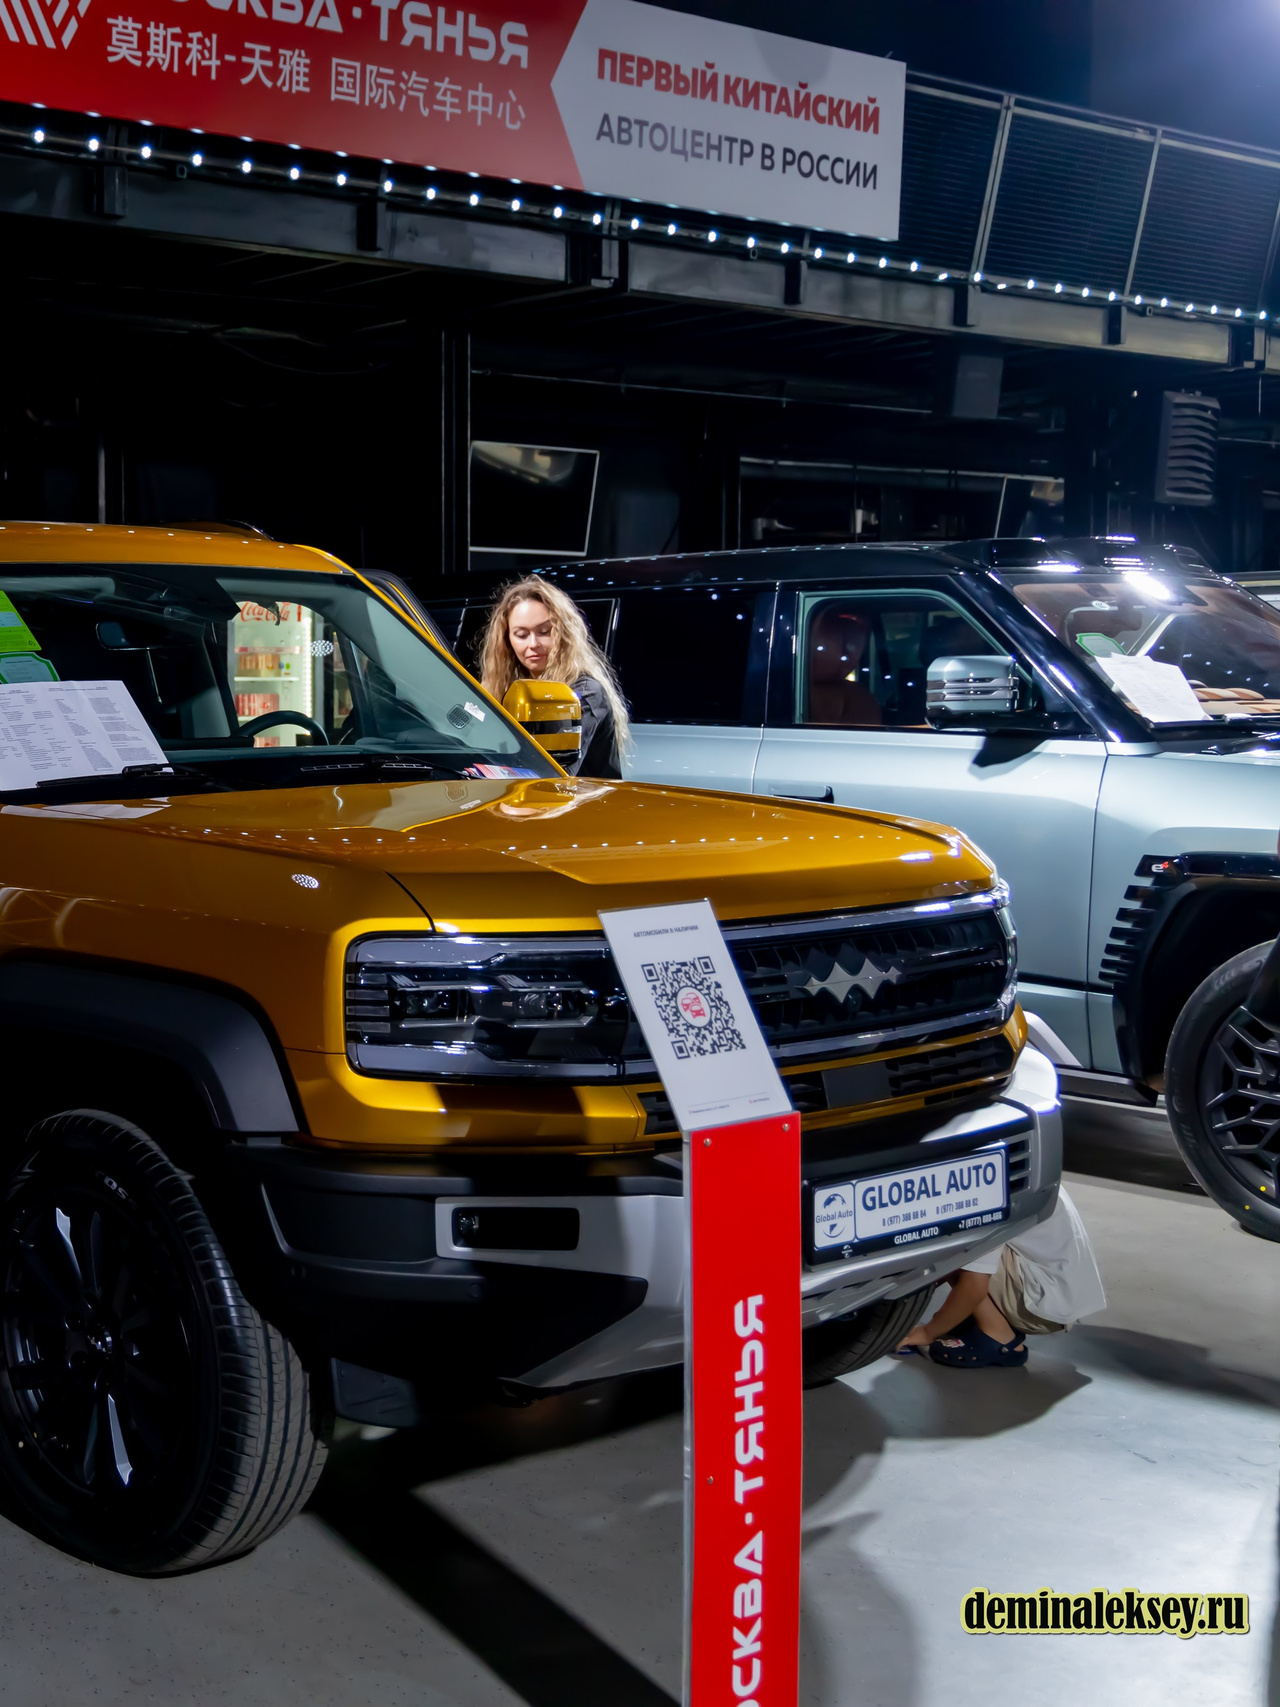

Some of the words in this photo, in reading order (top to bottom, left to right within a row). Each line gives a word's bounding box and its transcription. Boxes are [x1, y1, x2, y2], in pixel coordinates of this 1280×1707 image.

[106, 15, 310, 94] 莫斯科-天雅
[330, 56, 526, 130] 国际汽车中心
[597, 47, 719, 102] ПЕРВЫЙ
[723, 74, 880, 135] КИТАЙСКИЙ
[596, 112, 754, 166] АВТОЦЕНТР
[760, 142, 775, 172] В
[782, 147, 878, 190] РОССИИ
[815, 1211, 836, 1224] Global
[837, 1210, 853, 1219] Auto
[861, 1174, 941, 1212] GLOBAL
[945, 1162, 996, 1194] AUTO
[894, 1231, 920, 1245] GLOBAL
[921, 1226, 939, 1238] AUTO
